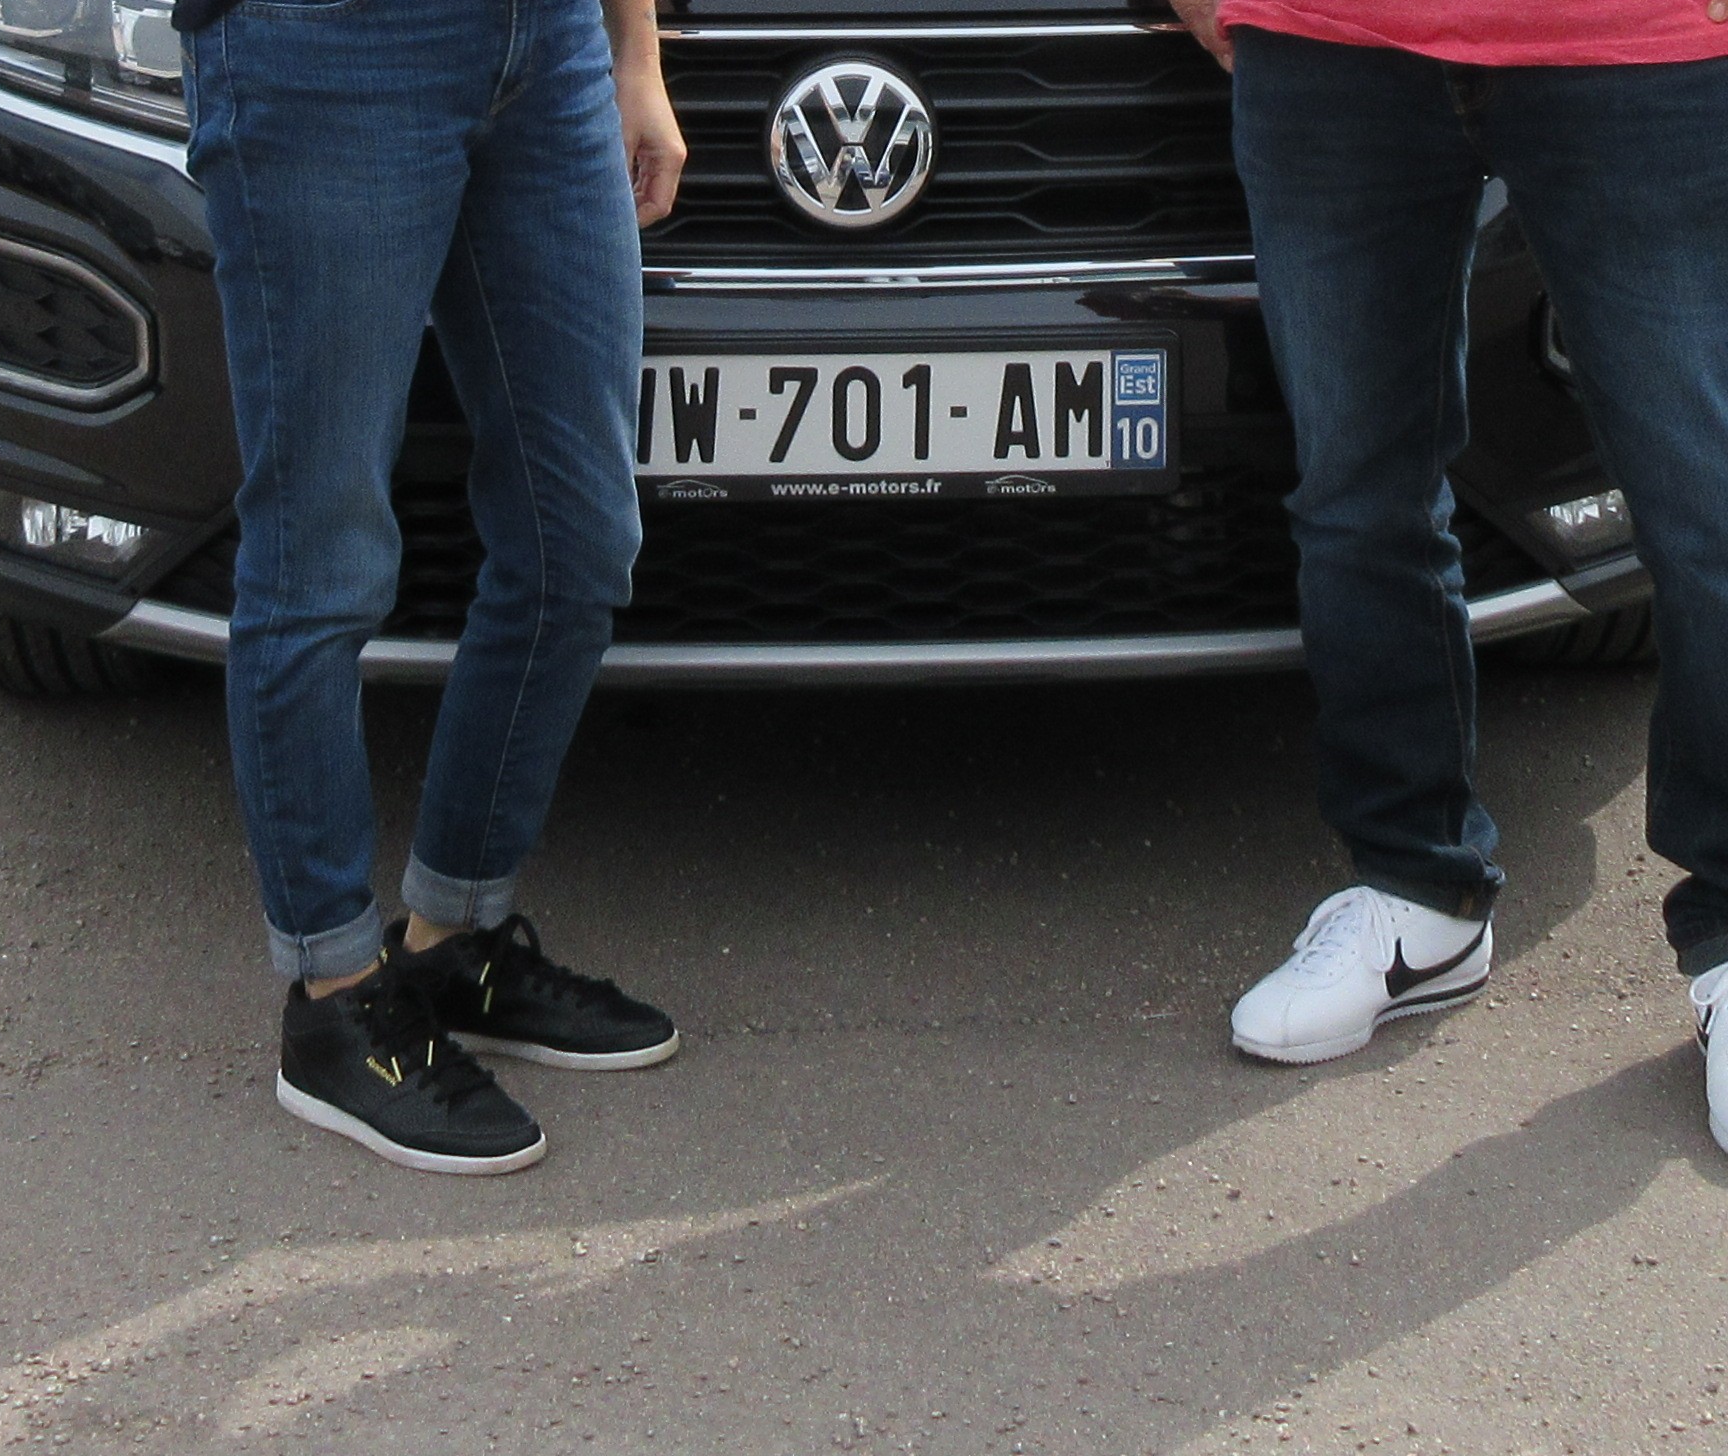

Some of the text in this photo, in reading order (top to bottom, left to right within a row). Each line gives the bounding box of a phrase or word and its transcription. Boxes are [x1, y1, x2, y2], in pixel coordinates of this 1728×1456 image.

[1119, 363, 1157, 375] Grand
[1119, 374, 1156, 395] Est
[1116, 416, 1159, 461] 10
[771, 478, 942, 496] www.e-motors.fr
